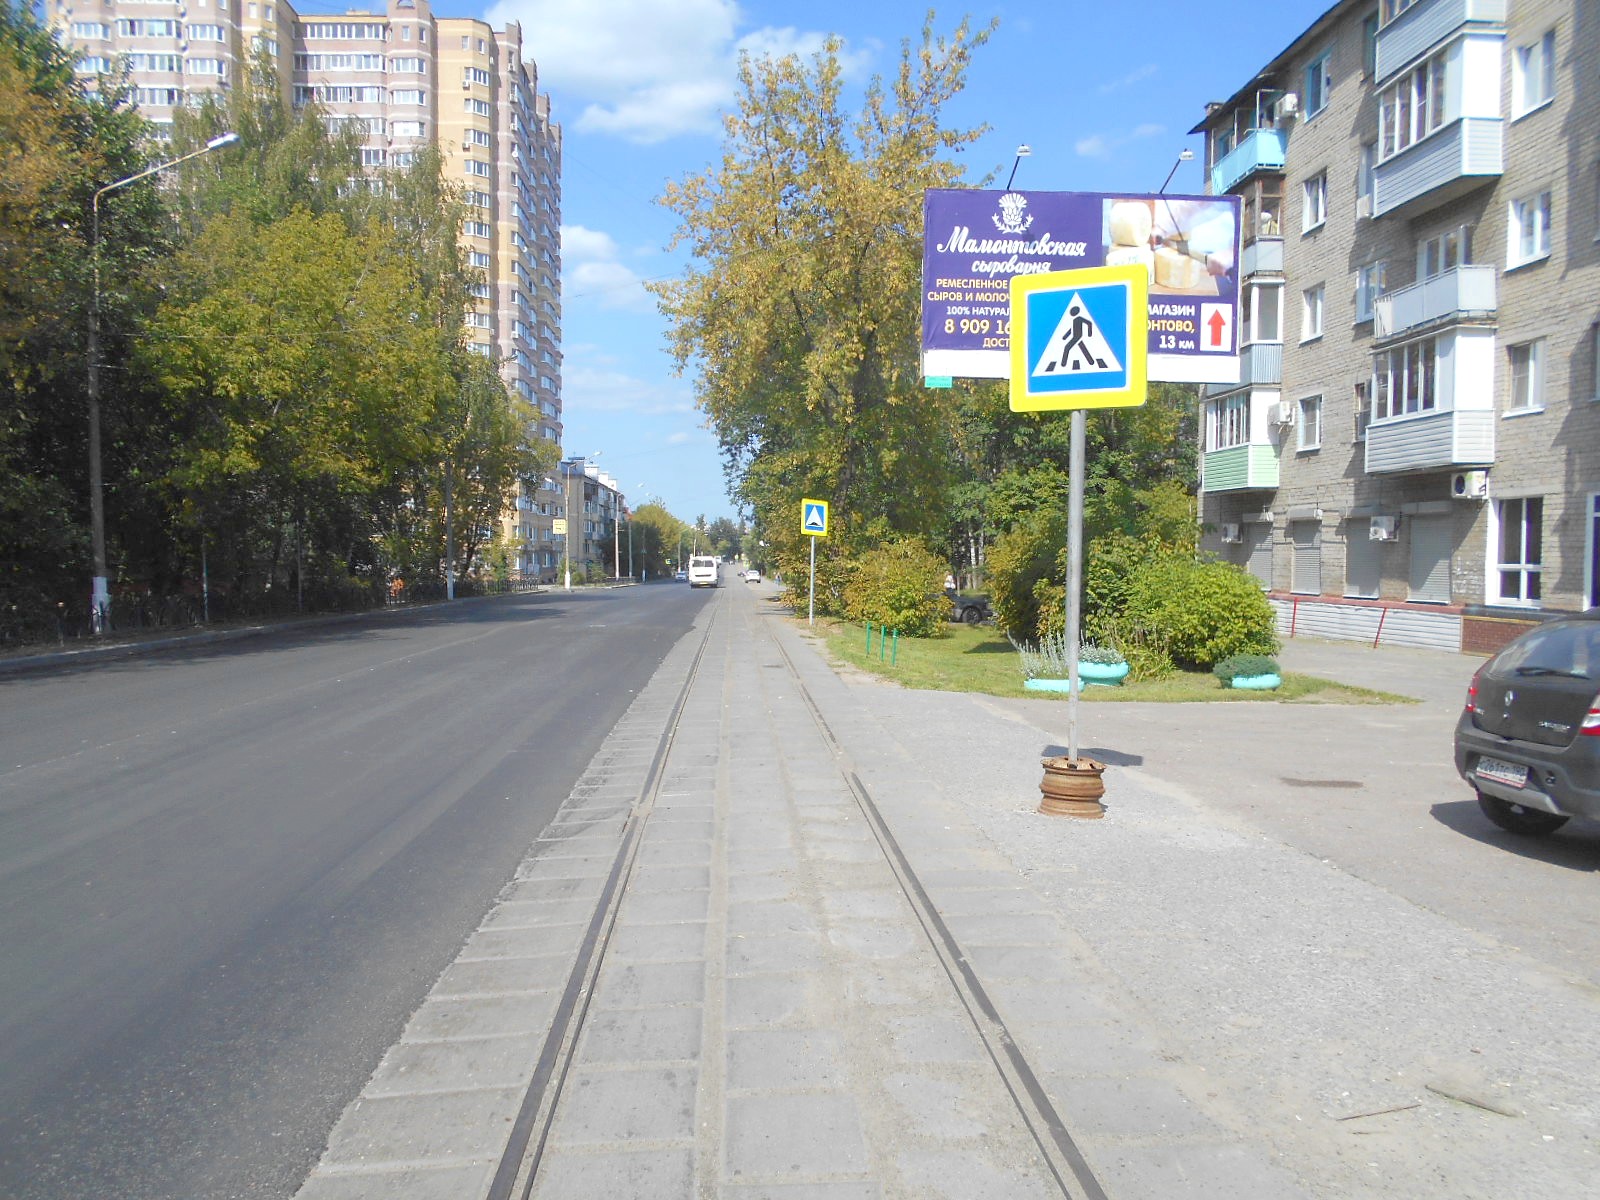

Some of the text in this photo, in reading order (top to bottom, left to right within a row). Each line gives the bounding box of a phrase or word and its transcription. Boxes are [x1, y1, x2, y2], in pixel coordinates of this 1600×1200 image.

[936, 226, 1087, 256] Мамонтовская
[971, 254, 1052, 278] сыроварня
[936, 279, 1008, 289] РЕМЕСЛЕННОЕ
[927, 291, 963, 301] СЫРОВ
[965, 292, 973, 302] И
[946, 306, 970, 315] 100%
[1147, 304, 1195, 316] АГАЗИН
[944, 319, 955, 334] 8
[960, 319, 990, 334] 909
[1159, 335, 1195, 350] 13 км
